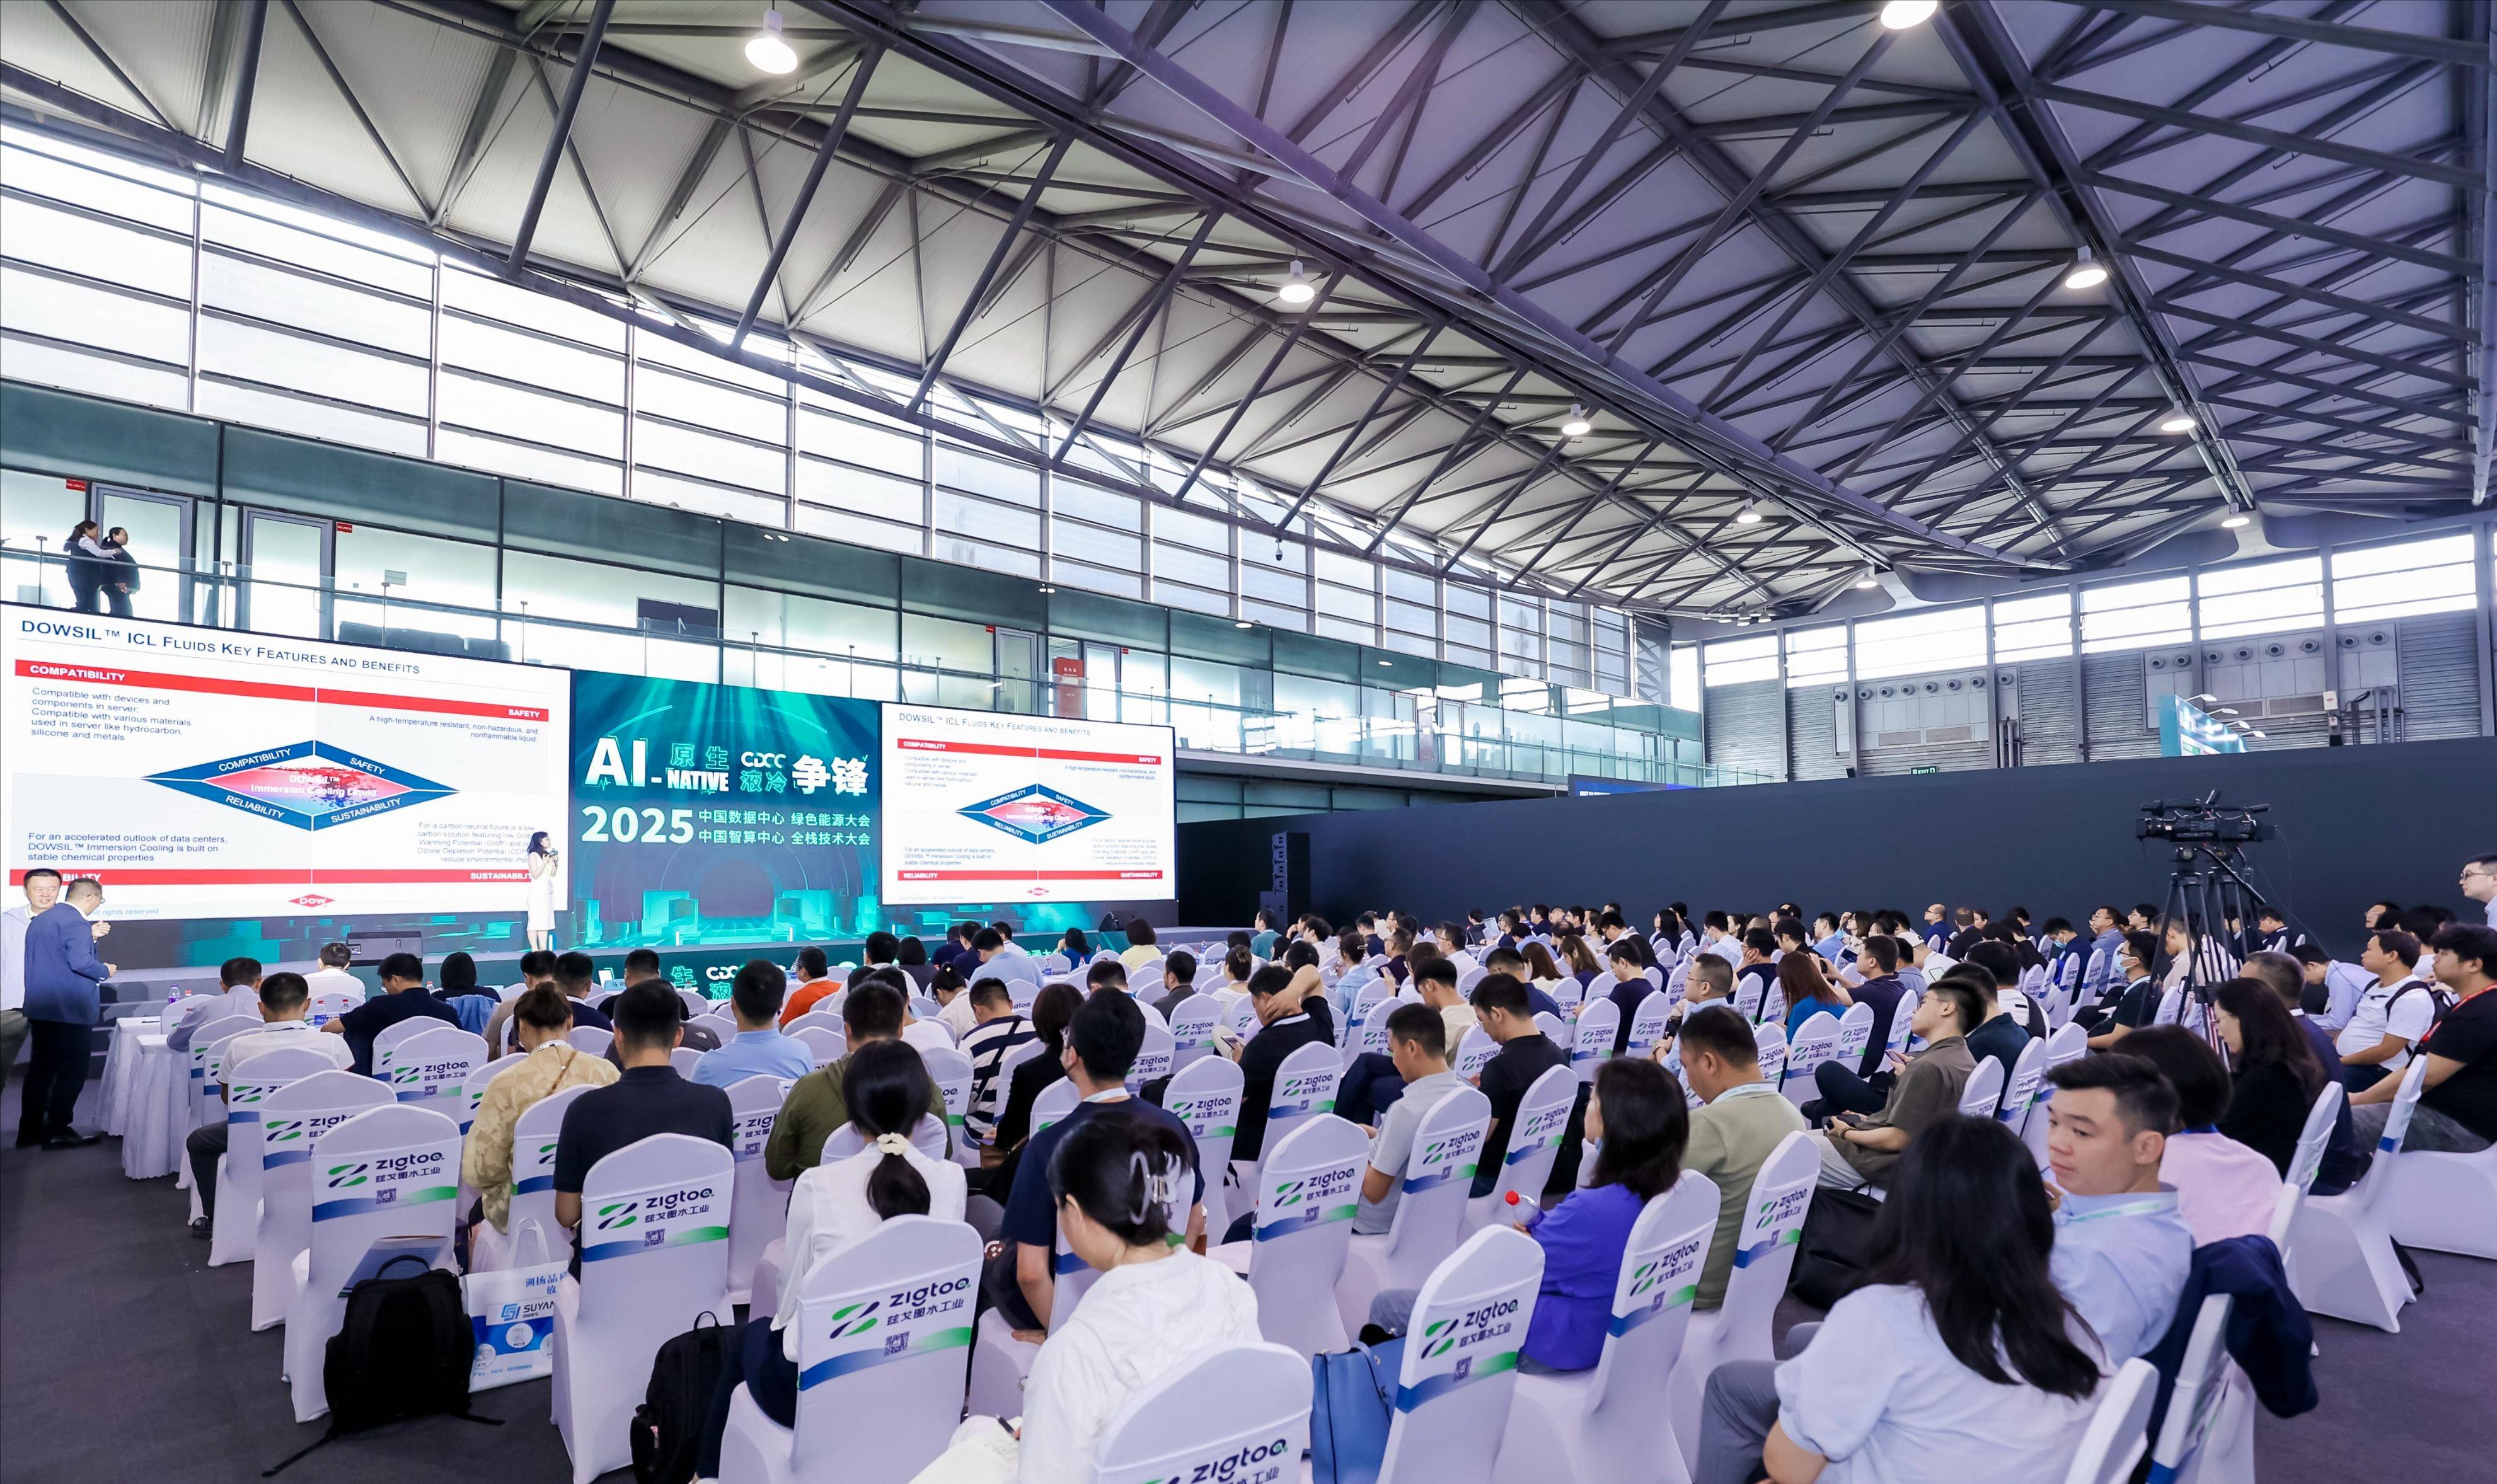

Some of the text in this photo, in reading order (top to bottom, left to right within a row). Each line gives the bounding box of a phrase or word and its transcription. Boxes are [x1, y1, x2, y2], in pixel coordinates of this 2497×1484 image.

[127, 632, 157, 647] ICL
[332, 657, 357, 668] AND
[362, 660, 420, 674] BENEFITS
[30, 665, 126, 681] COMPATIBILITY
[32, 687, 88, 699] Compatible
[115, 695, 149, 704] devices
[32, 699, 93, 709] components
[32, 708, 88, 719] Compatible
[151, 718, 191, 726] materials
[508, 709, 540, 718] SAFETY
[376, 716, 438, 728] high-temperature
[440, 720, 470, 729] resistant,
[473, 723, 524, 733] non-hazardous,
[32, 728, 69, 737] silicone
[94, 732, 125, 740] metals
[471, 731, 537, 743] nonflammable liquid.
[903, 741, 945, 750] COMPATIBILITY
[219, 749, 291, 771] COMPATIBILITY
[669, 743, 730, 771] 原生
[349, 757, 386, 775] SAFETY
[667, 769, 729, 792] NATIVE
[740, 771, 787, 793] 液冷
[792, 754, 869, 797] 争锋
[991, 790, 1026, 806] COMPATIBILITY
[1056, 795, 1074, 805] SAFETY
[225, 795, 285, 819] RELIABILITY
[331, 797, 401, 824] SUSTAINABILITY
[581, 805, 695, 844] 2025
[699, 808, 870, 827] 中国数据中心 绿色能源大会
[28, 832, 46, 841] For
[64, 832, 120, 842] accelerated
[124, 834, 156, 843] outlook
[160, 834, 170, 843] of
[699, 829, 870, 846] 中国智算中心 全栈技术大会
[994, 821, 1024, 837] RELIABILITY
[1046, 821, 1083, 839] SUSTAINABILITY
[28, 843, 73, 851] DOWSIL
[87, 844, 137, 852] Immersion
[140, 844, 173, 853] Cooling
[187, 844, 205, 853] built
[28, 853, 154, 863] stable chemical properties
